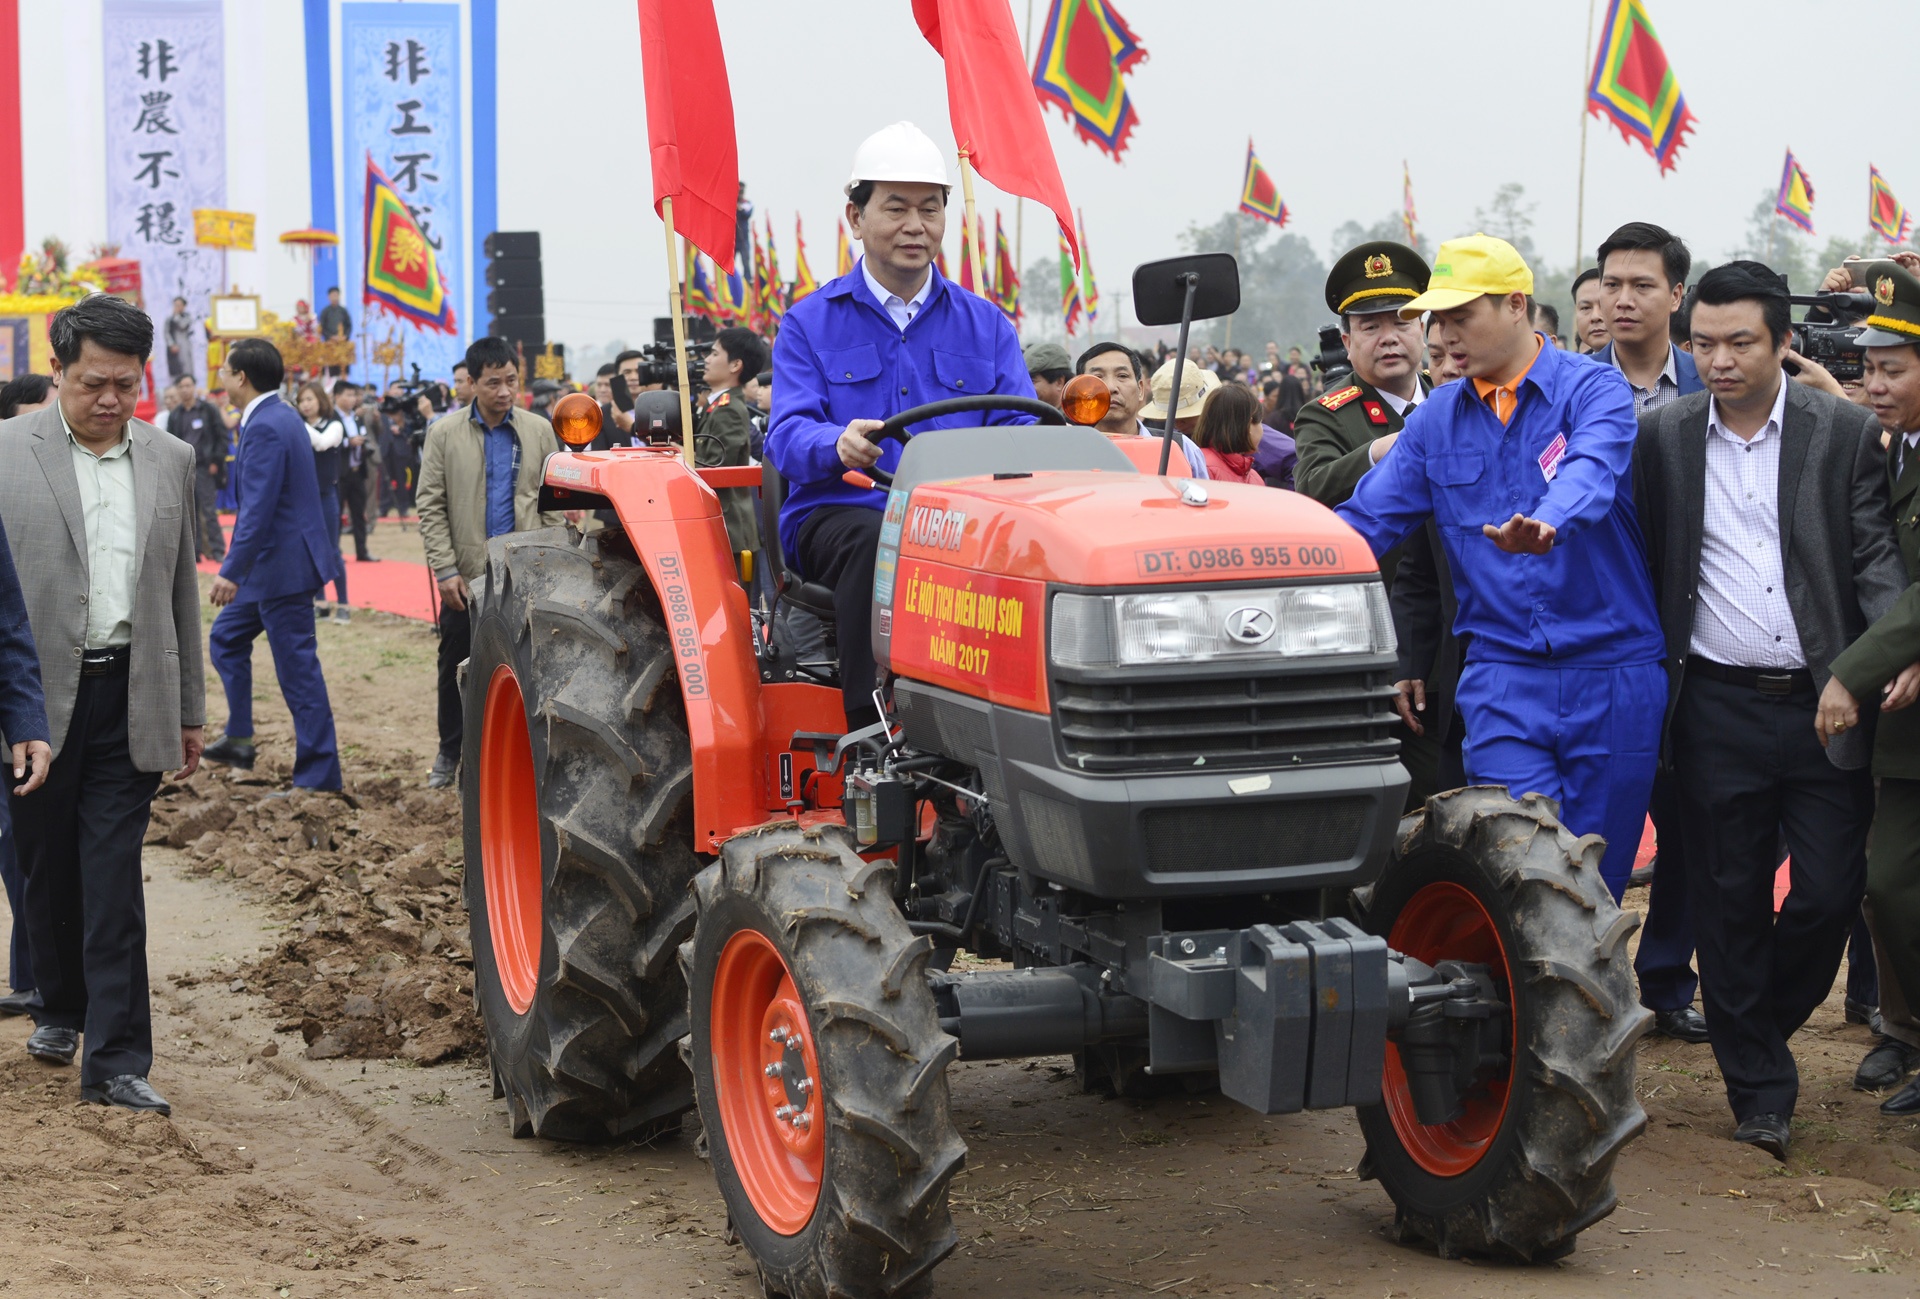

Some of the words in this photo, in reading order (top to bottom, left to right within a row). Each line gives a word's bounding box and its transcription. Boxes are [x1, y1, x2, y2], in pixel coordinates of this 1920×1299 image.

[909, 506, 965, 551] KUBOTA
[1187, 549, 1244, 569] 0986
[1251, 547, 1291, 566] 955
[1297, 547, 1337, 566] 000
[666, 585, 690, 623] 0986
[917, 574, 935, 623] HỘI
[935, 584, 954, 627] TỊCH
[977, 594, 997, 639] ĐỌI
[997, 597, 1023, 638] SƠN
[676, 627, 698, 658] 955
[929, 630, 956, 667] NĂM
[958, 643, 990, 675] 2017
[683, 663, 705, 695] 000
